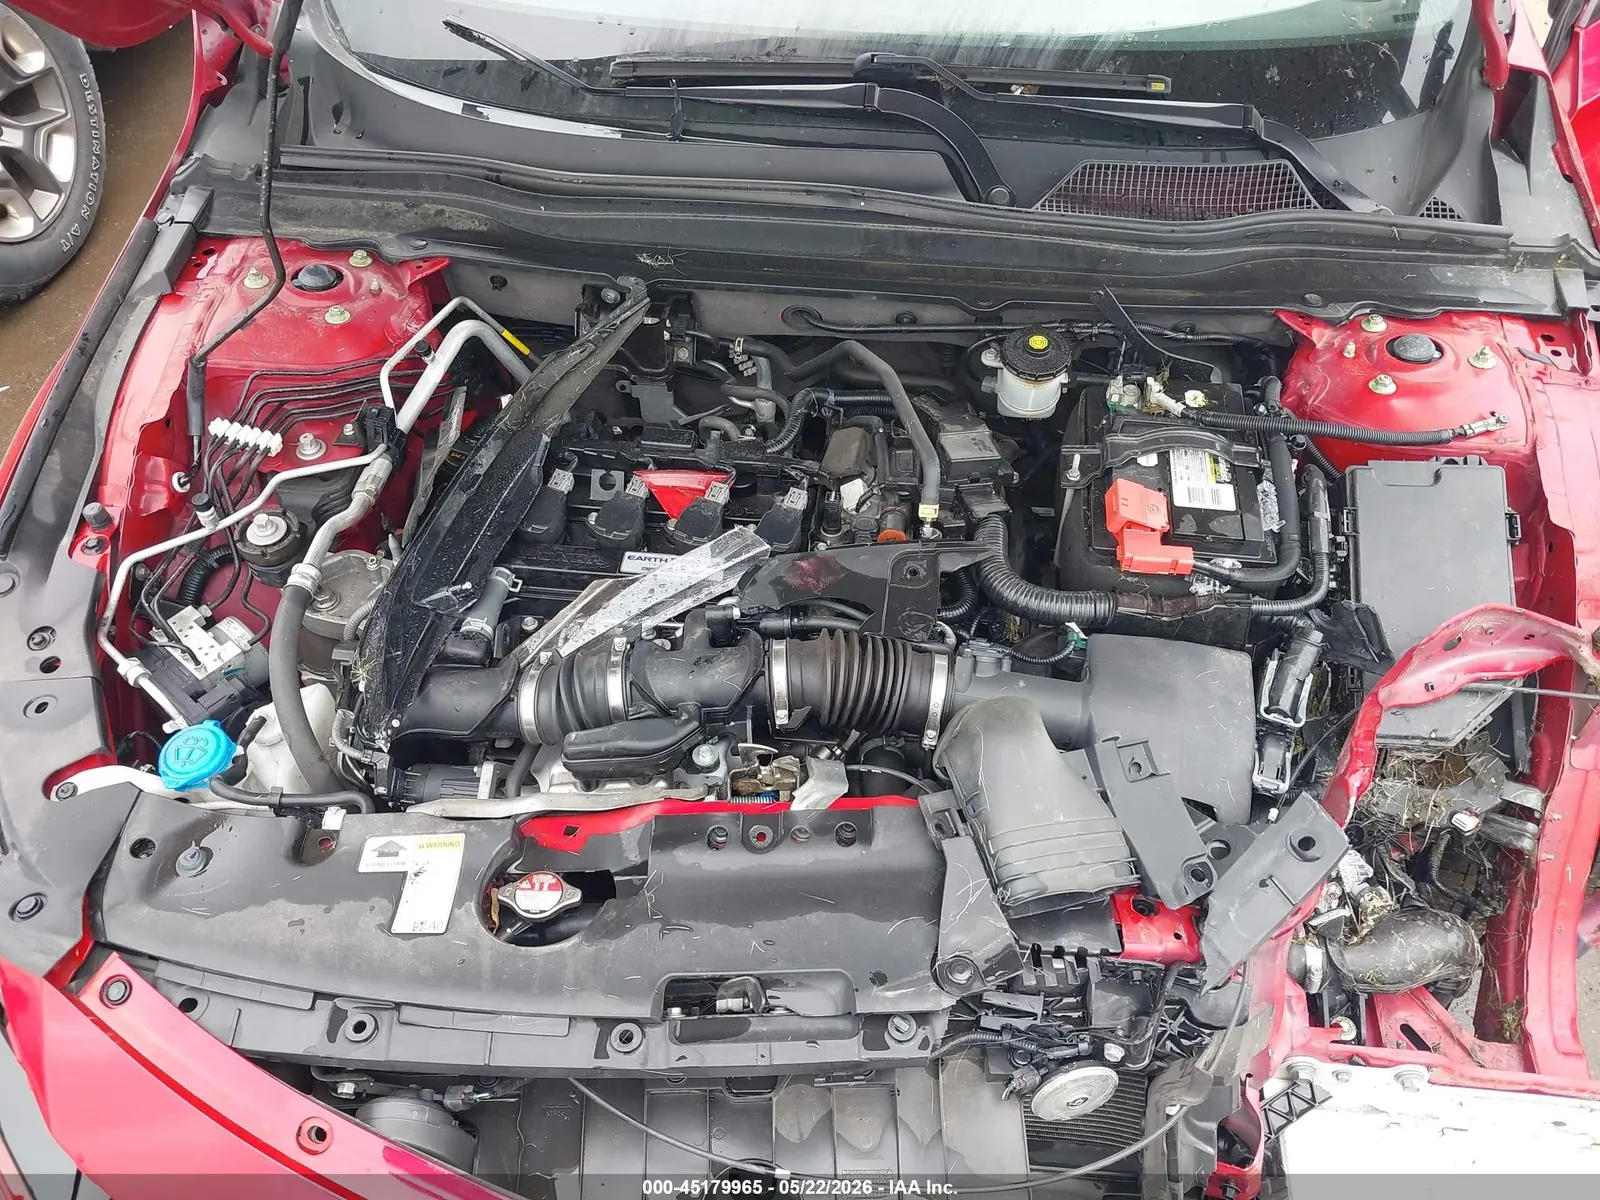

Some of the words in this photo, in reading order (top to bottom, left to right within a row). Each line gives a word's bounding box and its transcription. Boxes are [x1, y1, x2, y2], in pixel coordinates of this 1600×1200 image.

[79, 73, 101, 220] DESTINATION
[60, 223, 81, 252] A/T
[627, 555, 669, 564] EARTH
[426, 840, 461, 849] WARNING
